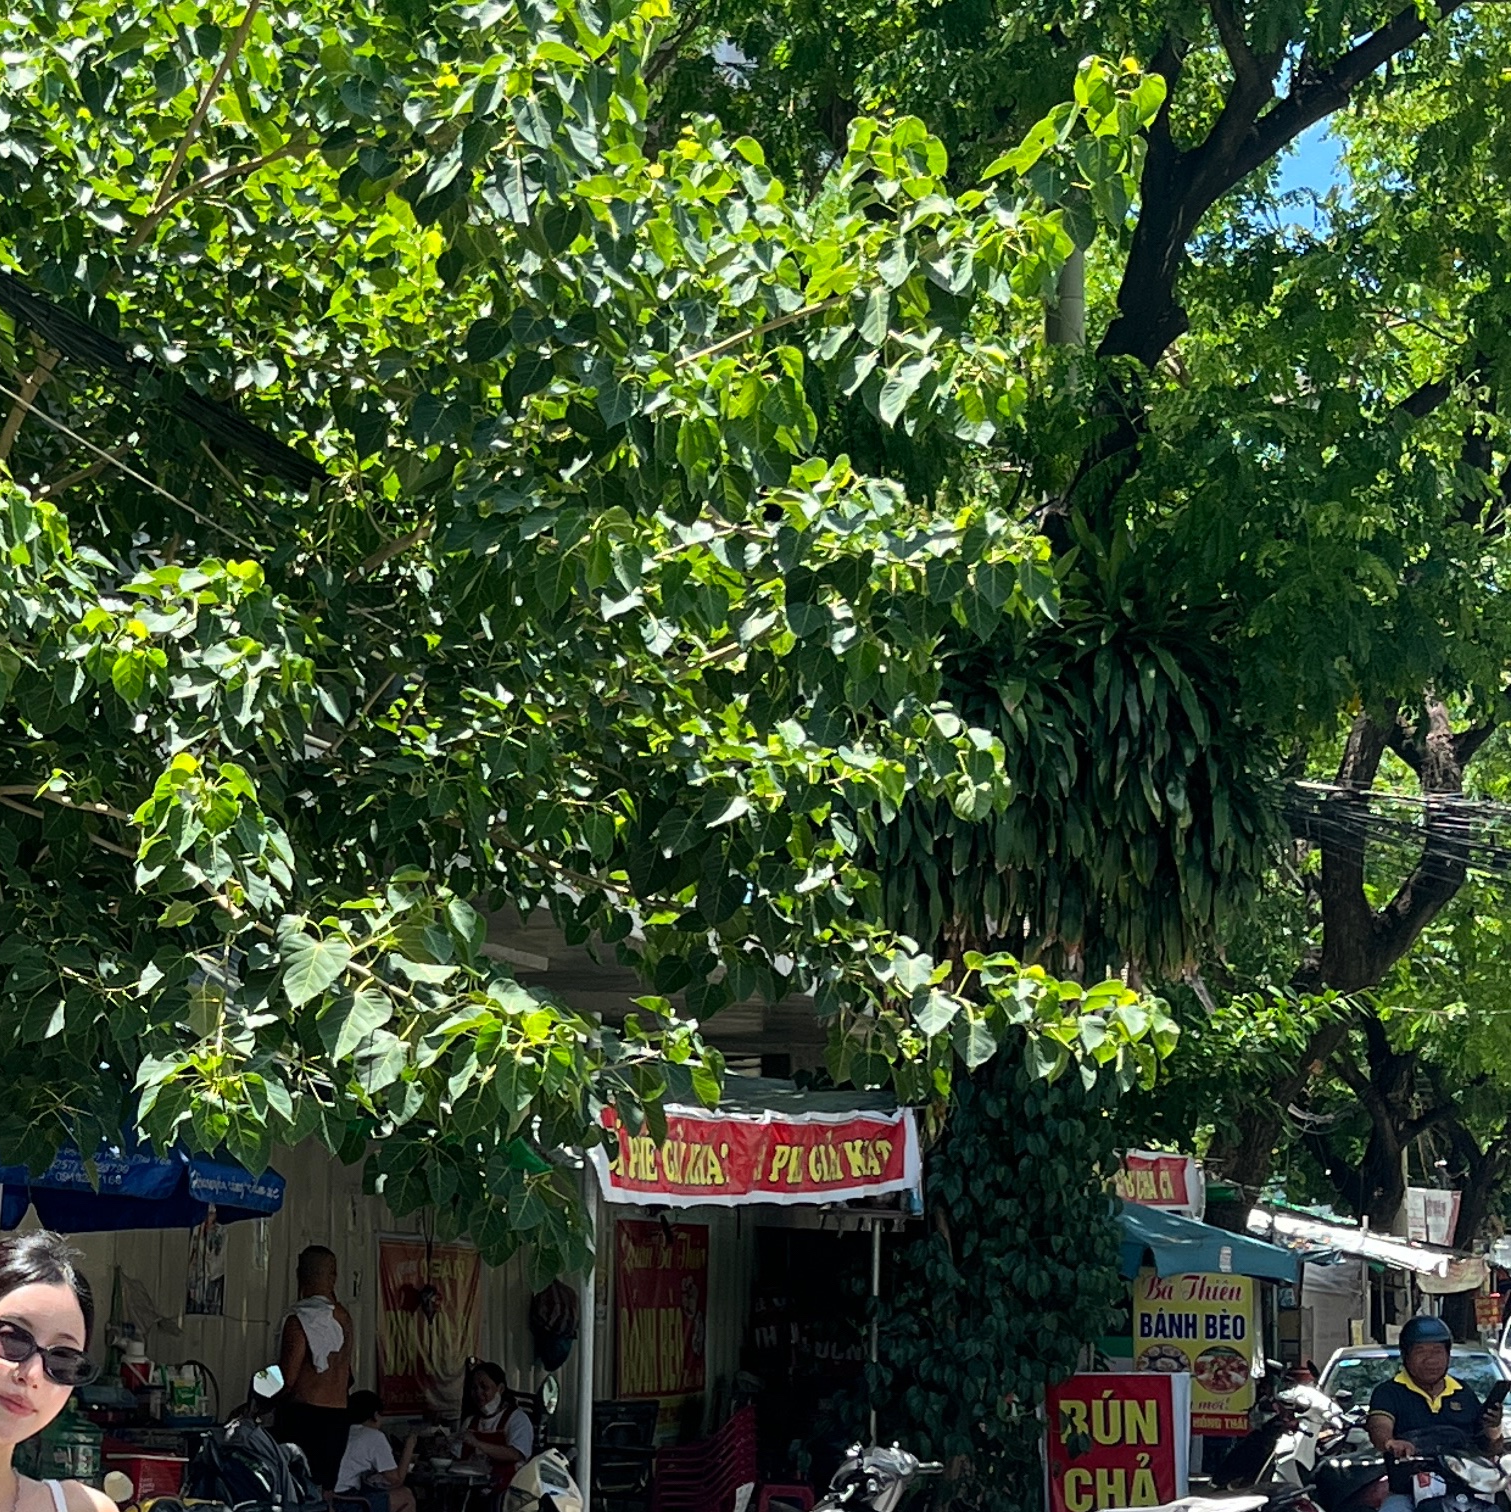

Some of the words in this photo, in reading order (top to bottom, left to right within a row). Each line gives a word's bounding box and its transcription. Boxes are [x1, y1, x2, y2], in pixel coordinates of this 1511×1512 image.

[1140, 1307, 1197, 1339] BÁNH
[1205, 1308, 1246, 1340] BÈO
[1058, 1389, 1160, 1446] BÚN
